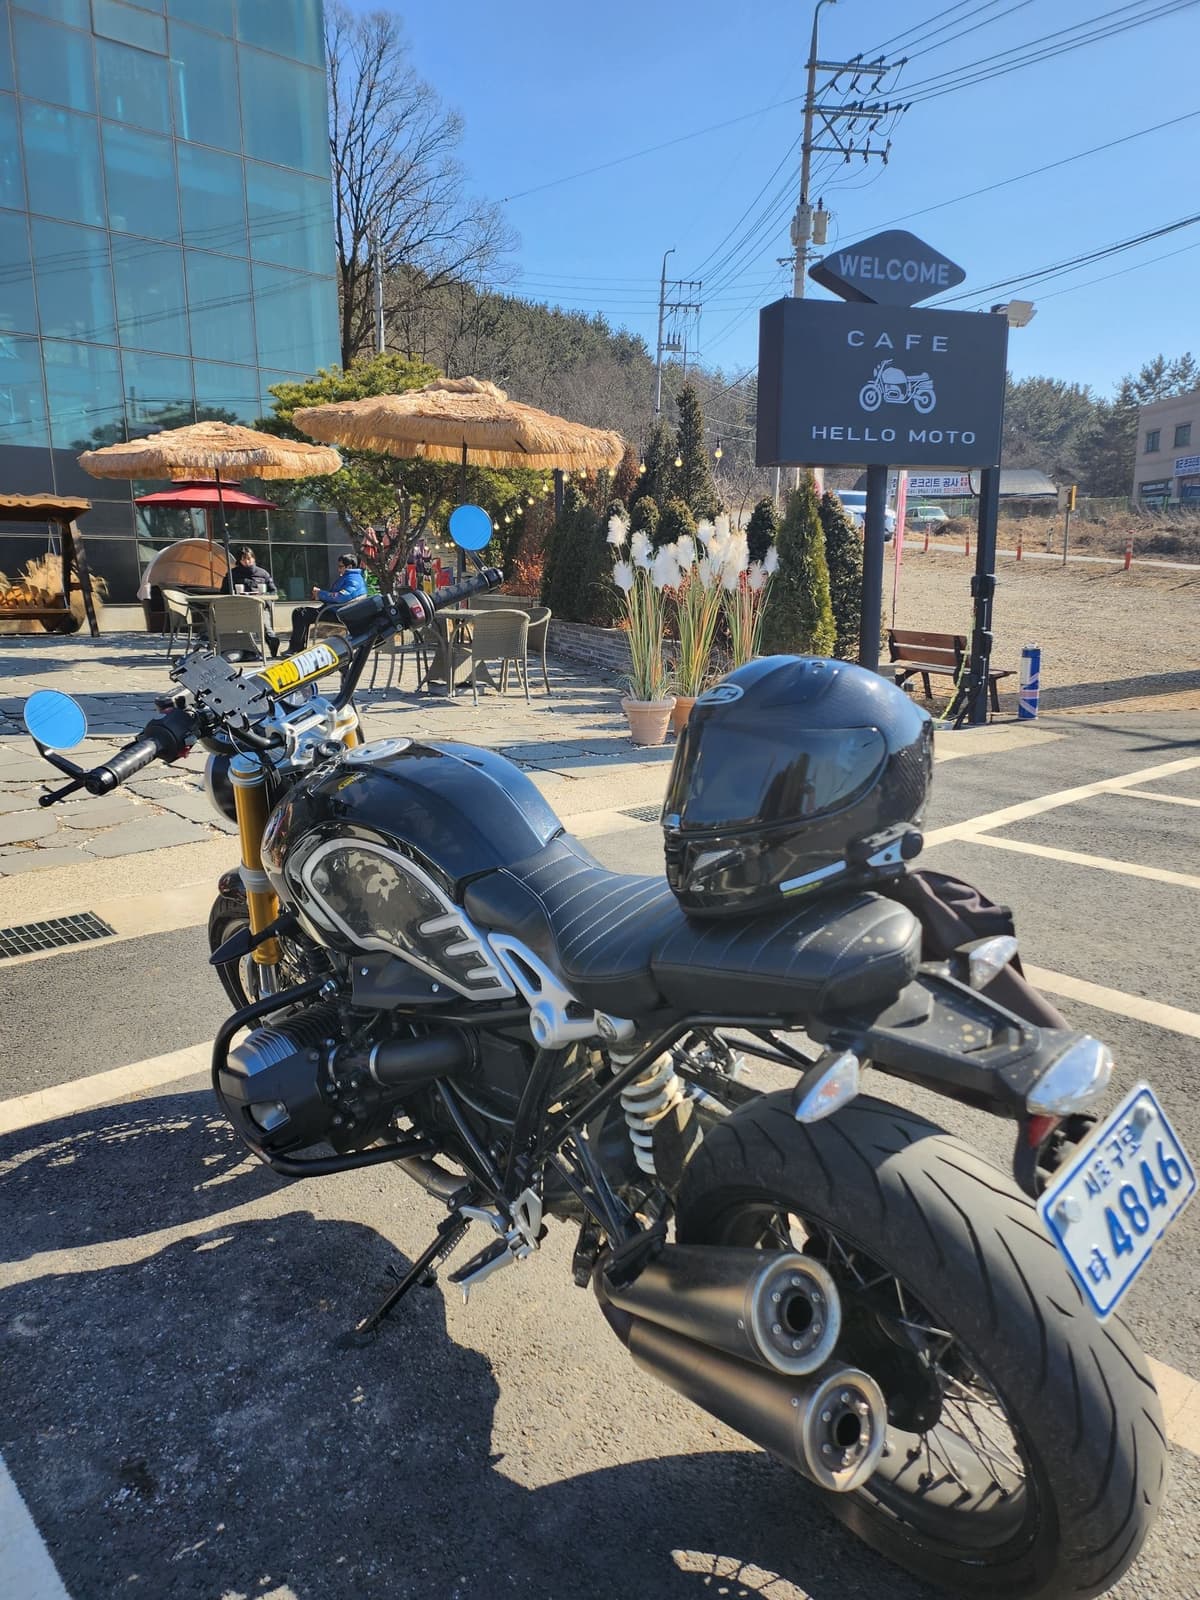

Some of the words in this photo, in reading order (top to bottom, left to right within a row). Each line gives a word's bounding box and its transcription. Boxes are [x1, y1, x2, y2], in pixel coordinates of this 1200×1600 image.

[838, 254, 950, 286] WELCOME
[847, 330, 949, 352] CAFE
[811, 425, 896, 442] HELLO
[908, 429, 976, 445] MOTO
[909, 477, 940, 488] 콘크리트
[942, 477, 959, 488] 공사
[1083, 1158, 1114, 1199] 서울
[1103, 1140, 1183, 1259] 4846
